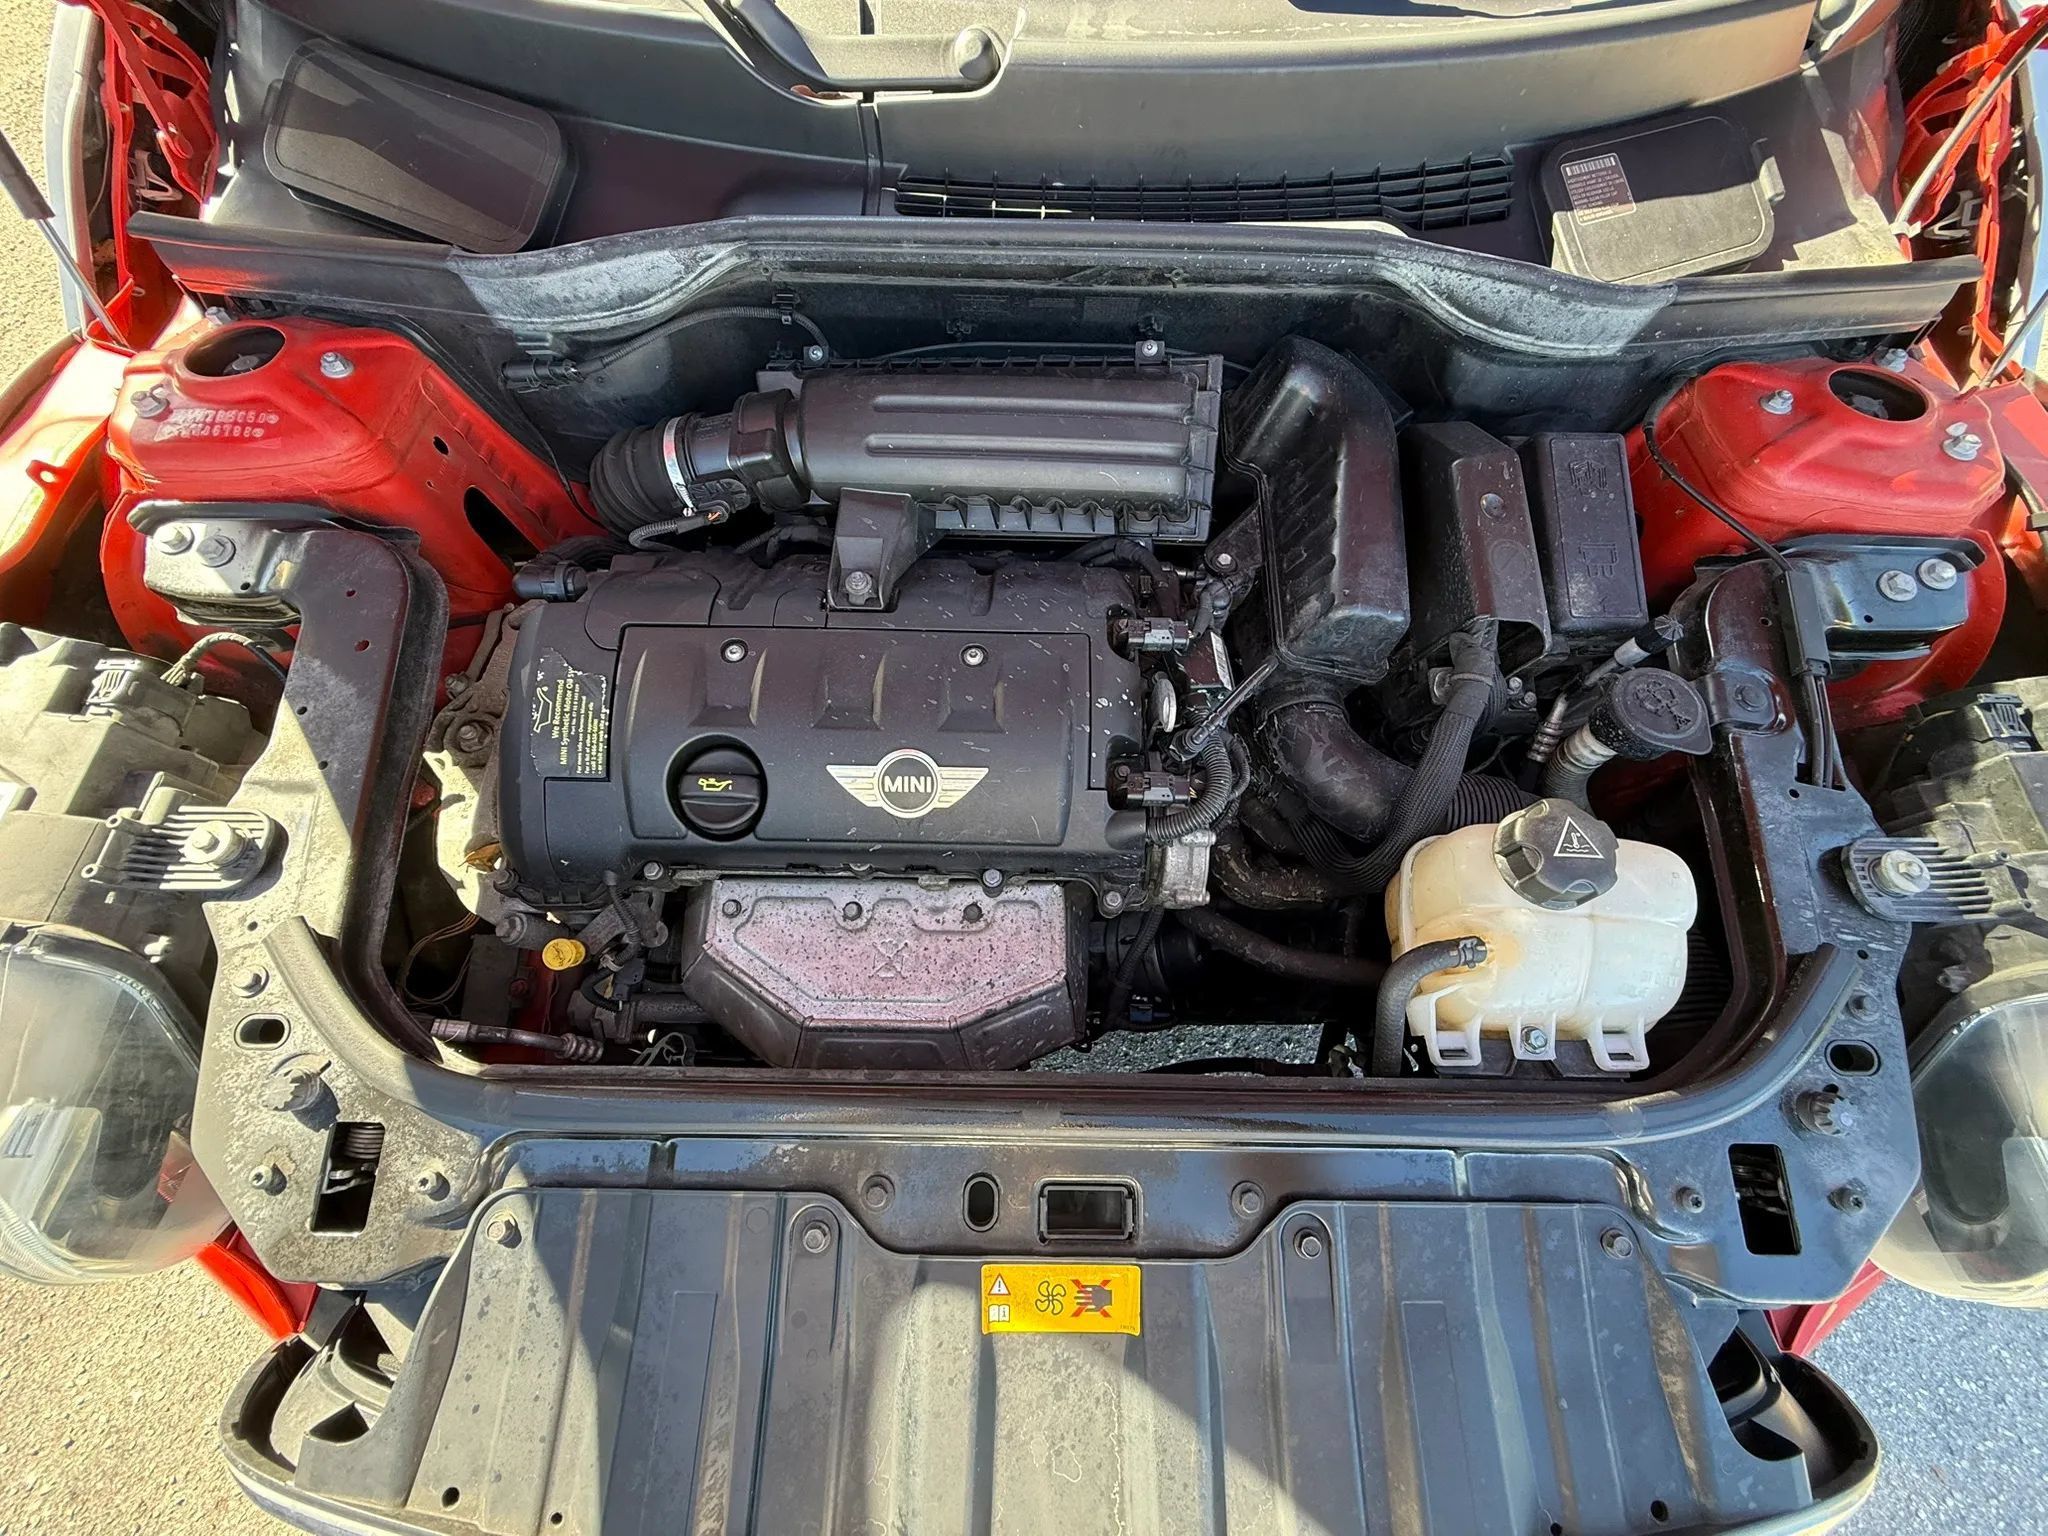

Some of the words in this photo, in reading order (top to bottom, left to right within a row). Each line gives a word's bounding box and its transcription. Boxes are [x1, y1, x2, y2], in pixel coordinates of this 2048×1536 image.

[553, 680, 564, 725] Recommend
[564, 690, 572, 712] Motor
[552, 726, 559, 738] We
[561, 713, 570, 746] Synthetic
[884, 776, 931, 793] MINI
